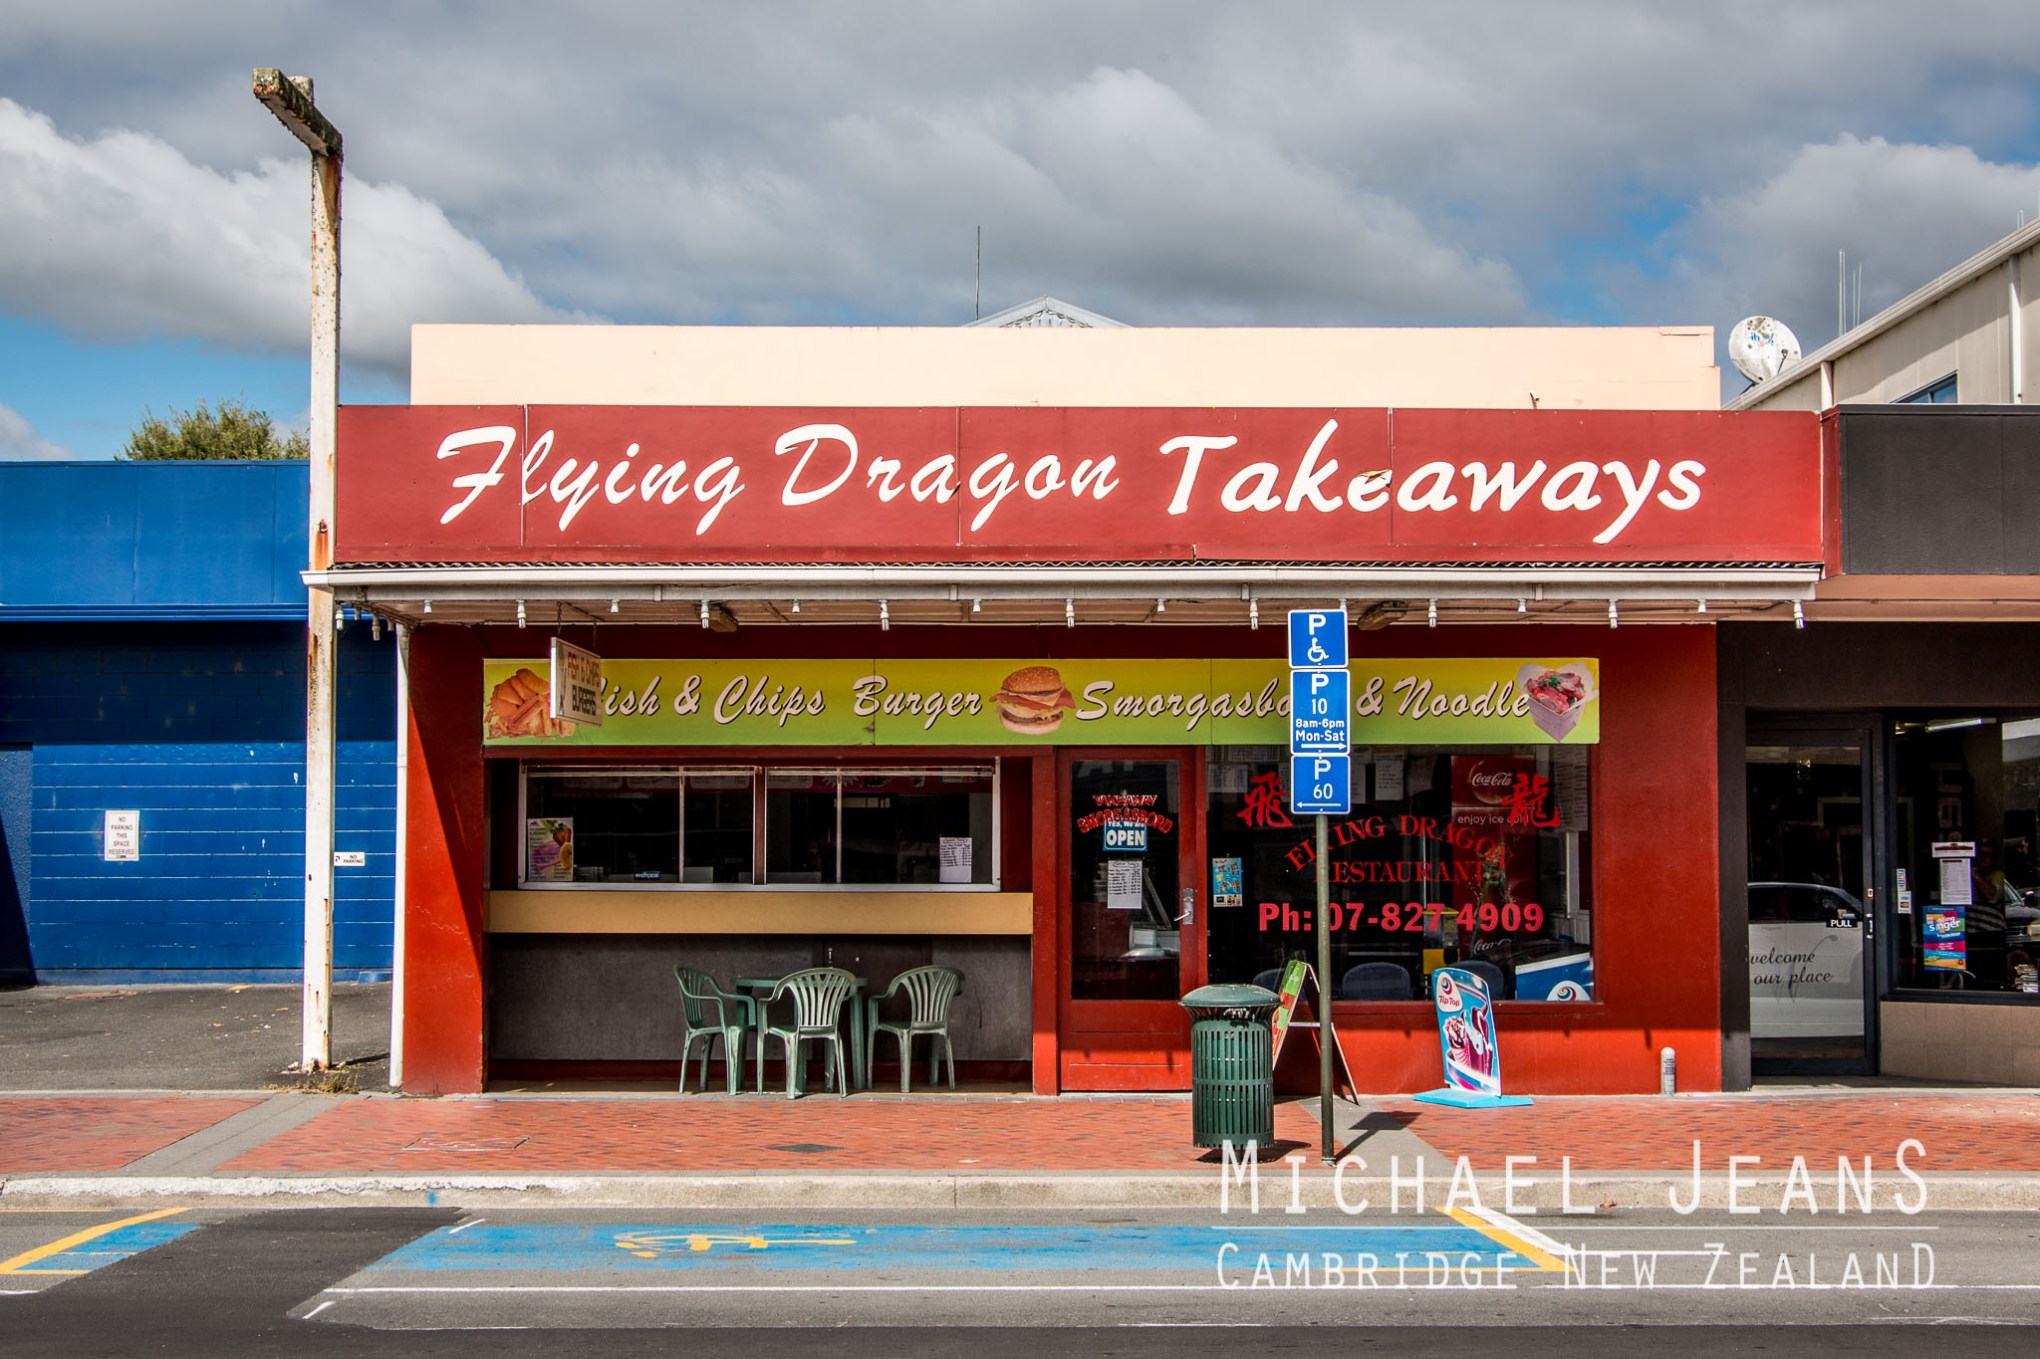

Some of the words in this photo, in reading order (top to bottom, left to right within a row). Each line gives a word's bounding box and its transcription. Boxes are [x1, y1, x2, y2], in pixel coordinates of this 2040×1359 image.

[437, 426, 745, 535] Flying
[775, 423, 1119, 532] Dragon
[1160, 418, 1706, 545] Takeaways
[1308, 613, 1327, 635] P
[1311, 673, 1330, 695] P
[674, 675, 701, 716] &
[713, 675, 826, 727] Chips
[853, 675, 982, 731] Burger
[1075, 677, 1292, 732] Smorgasbo
[1356, 676, 1385, 717] &
[1392, 676, 1530, 718] Noodle
[1311, 698, 1328, 715] 10
[1295, 718, 1345, 730] 8am-6pm
[1295, 729, 1345, 742] Mon-Sat
[1314, 759, 1331, 780] P
[1093, 794, 1158, 807] TAKEAWAY
[1313, 783, 1333, 800] 60
[1502, 772, 1561, 827] 龍
[1457, 814, 1486, 826] enjoy
[1489, 814, 1504, 824] ice
[1106, 829, 1145, 846] OPEN
[1284, 815, 1386, 872] FLING
[1312, 861, 1485, 883] ESTAURANT
[1258, 902, 1312, 932] Ph:
[1327, 902, 1447, 932] 07-827
[1456, 902, 1544, 932] 4909
[1830, 919, 1853, 928] PULL
[1753, 974, 1784, 985] our
[1787, 965, 1834, 989] place
[1438, 995, 1449, 1005] Tip
[1449, 997, 1461, 1007] Top
